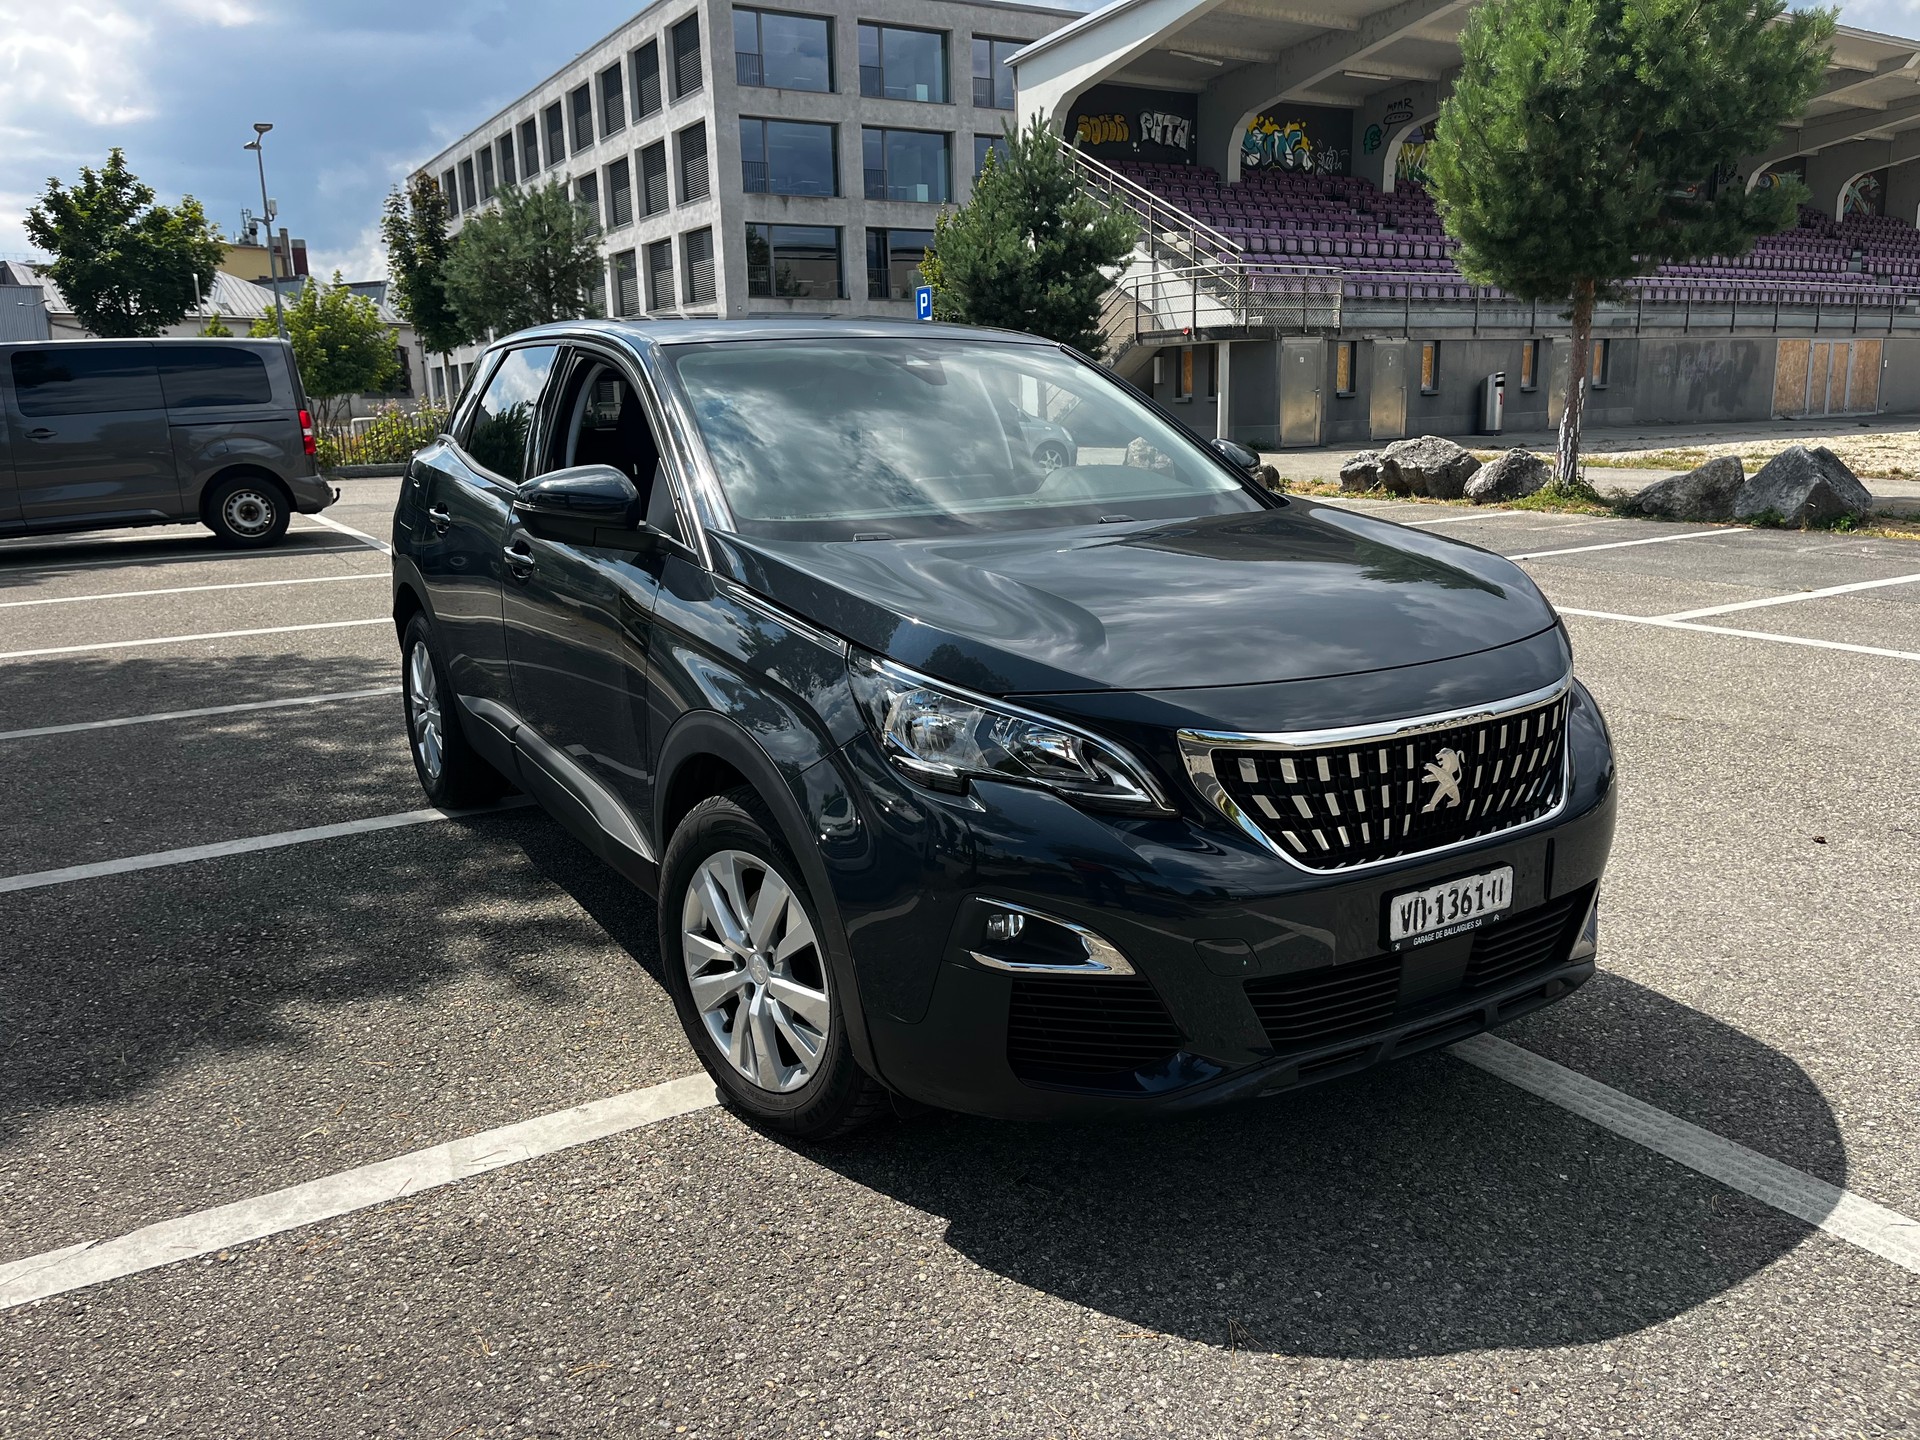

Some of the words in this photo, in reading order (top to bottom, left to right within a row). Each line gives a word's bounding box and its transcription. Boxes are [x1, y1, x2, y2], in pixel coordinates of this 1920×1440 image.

[920, 293, 928, 315] P
[1413, 932, 1436, 946] GARAGE
[1435, 930, 1443, 939] DE
[1443, 922, 1475, 937] BALLAIGUES
[1474, 919, 1483, 928] SA
